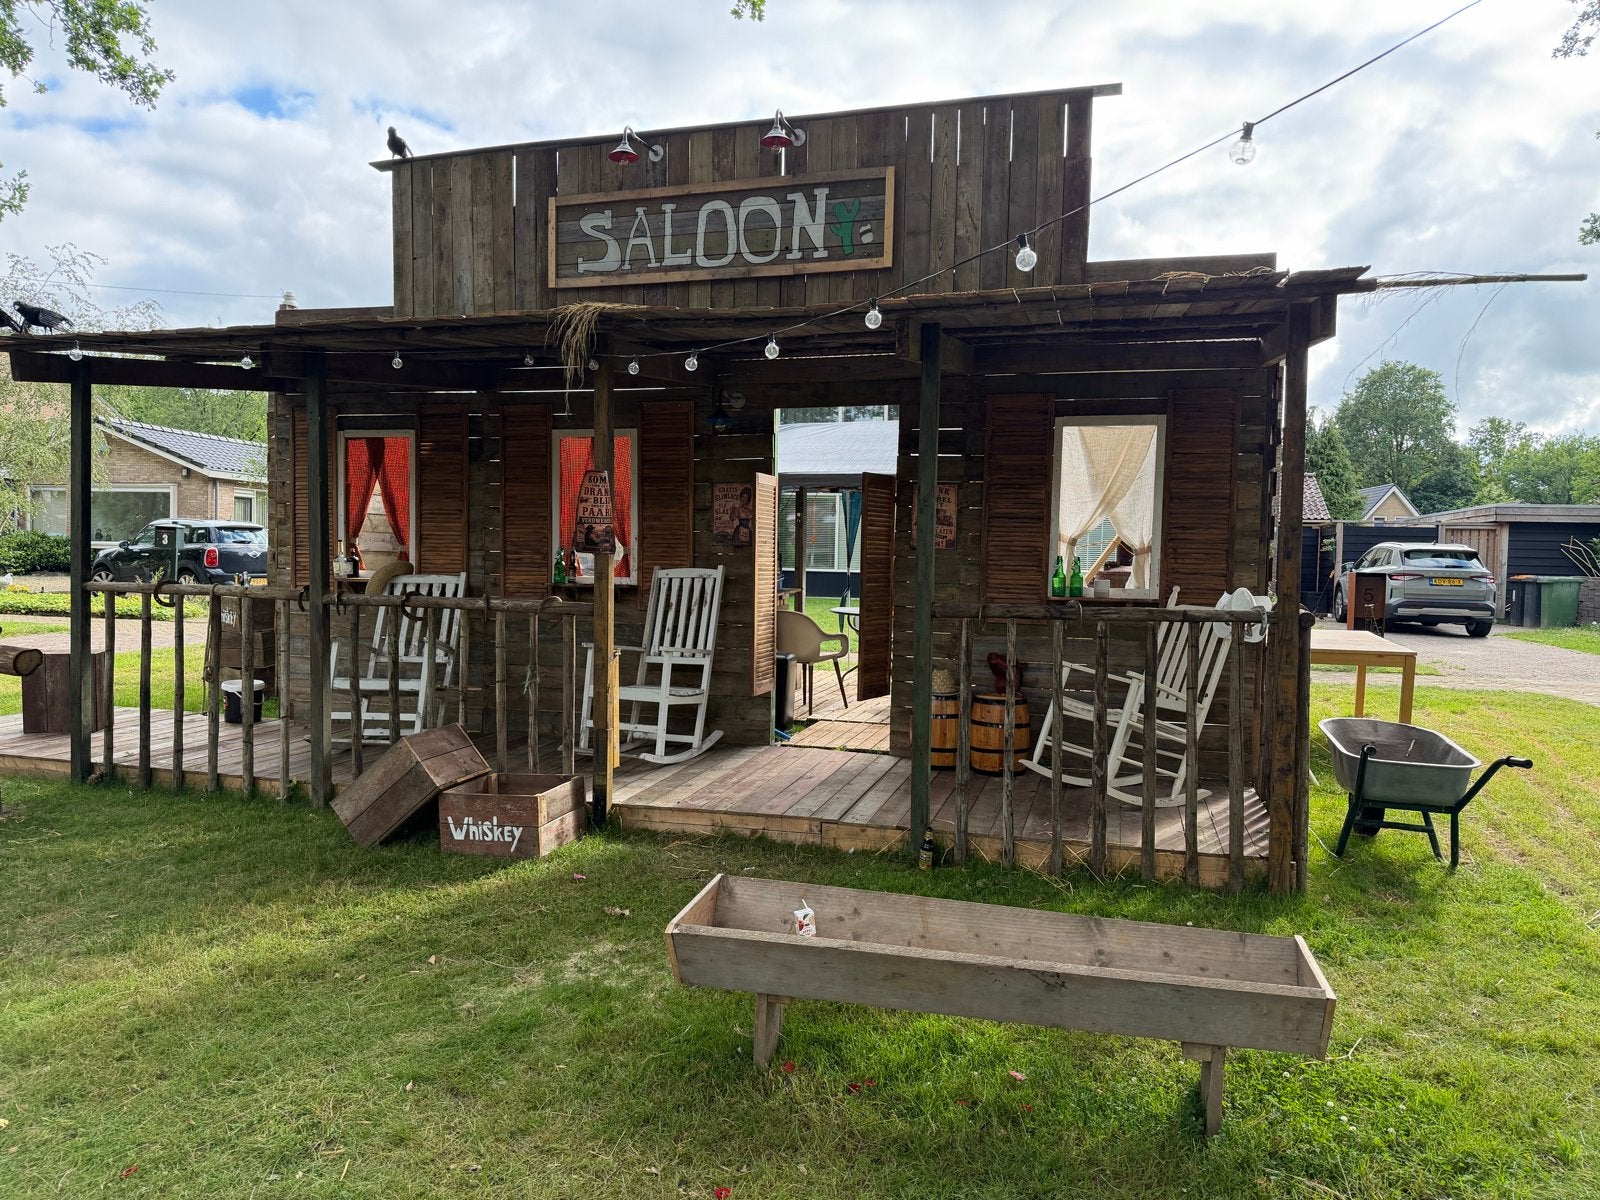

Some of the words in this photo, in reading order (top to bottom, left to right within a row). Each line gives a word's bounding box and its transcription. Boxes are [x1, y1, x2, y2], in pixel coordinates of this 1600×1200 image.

[577, 187, 830, 274] SALOON
[588, 475, 607, 484] KOM
[162, 534, 169, 545] 3
[1363, 588, 1374, 602] 5
